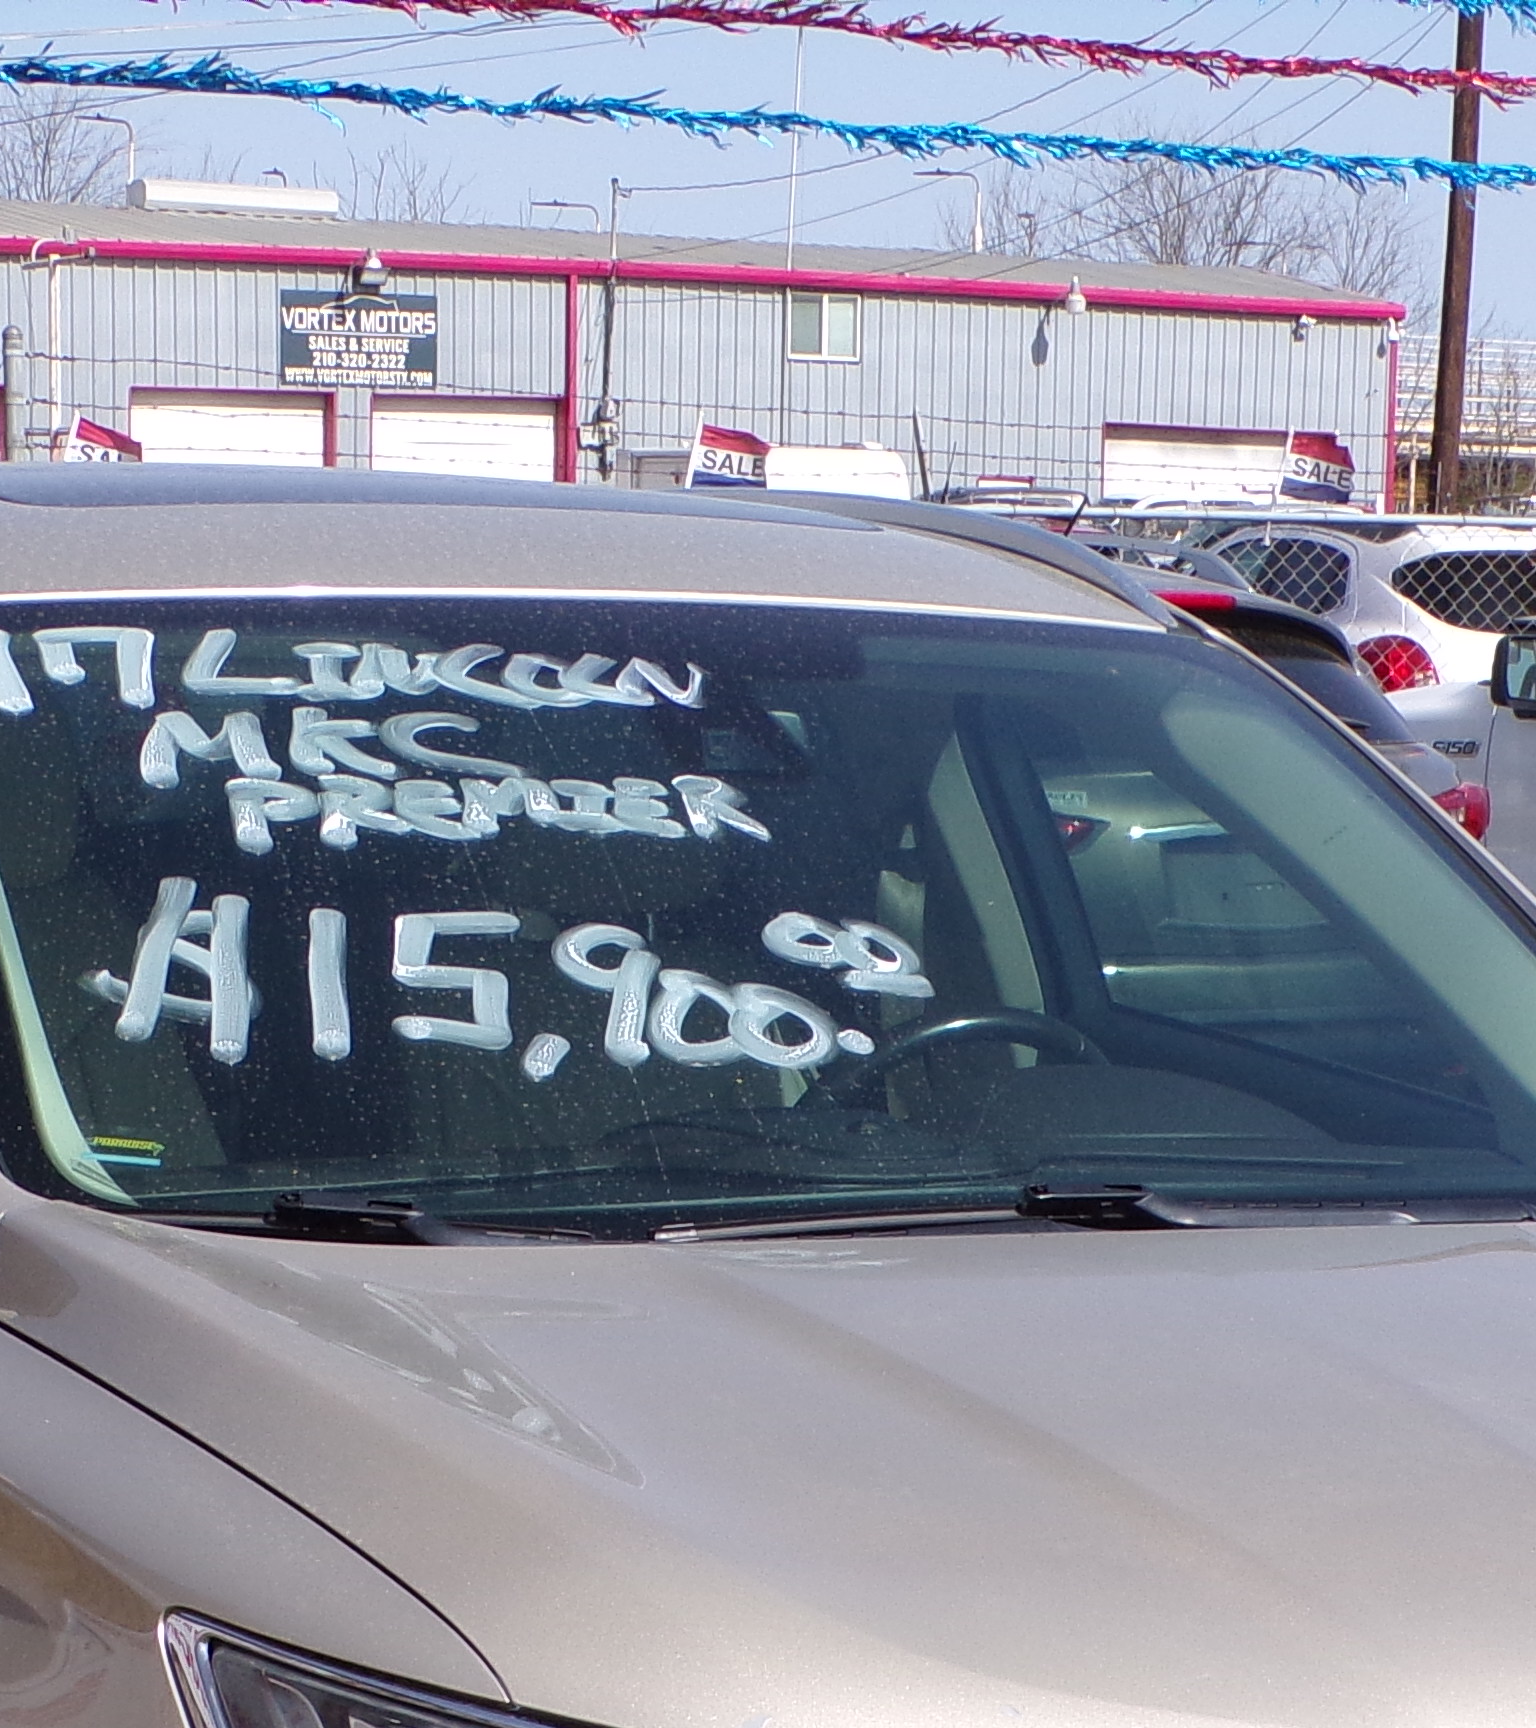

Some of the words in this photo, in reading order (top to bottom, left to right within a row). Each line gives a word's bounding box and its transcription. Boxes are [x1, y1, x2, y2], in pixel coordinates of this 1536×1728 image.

[282, 307, 356, 331] VORTEX
[360, 309, 436, 334] MOTORS
[308, 335, 347, 351] SALES
[349, 338, 359, 351] &
[362, 338, 410, 353] SERVICE
[312, 352, 406, 369] 210-320-2322
[702, 449, 764, 478] SALE
[1292, 457, 1351, 489] SALE
[182, 627, 707, 710] LINCOLN
[139, 706, 526, 790] MKC
[224, 771, 772, 856] PREMIER
